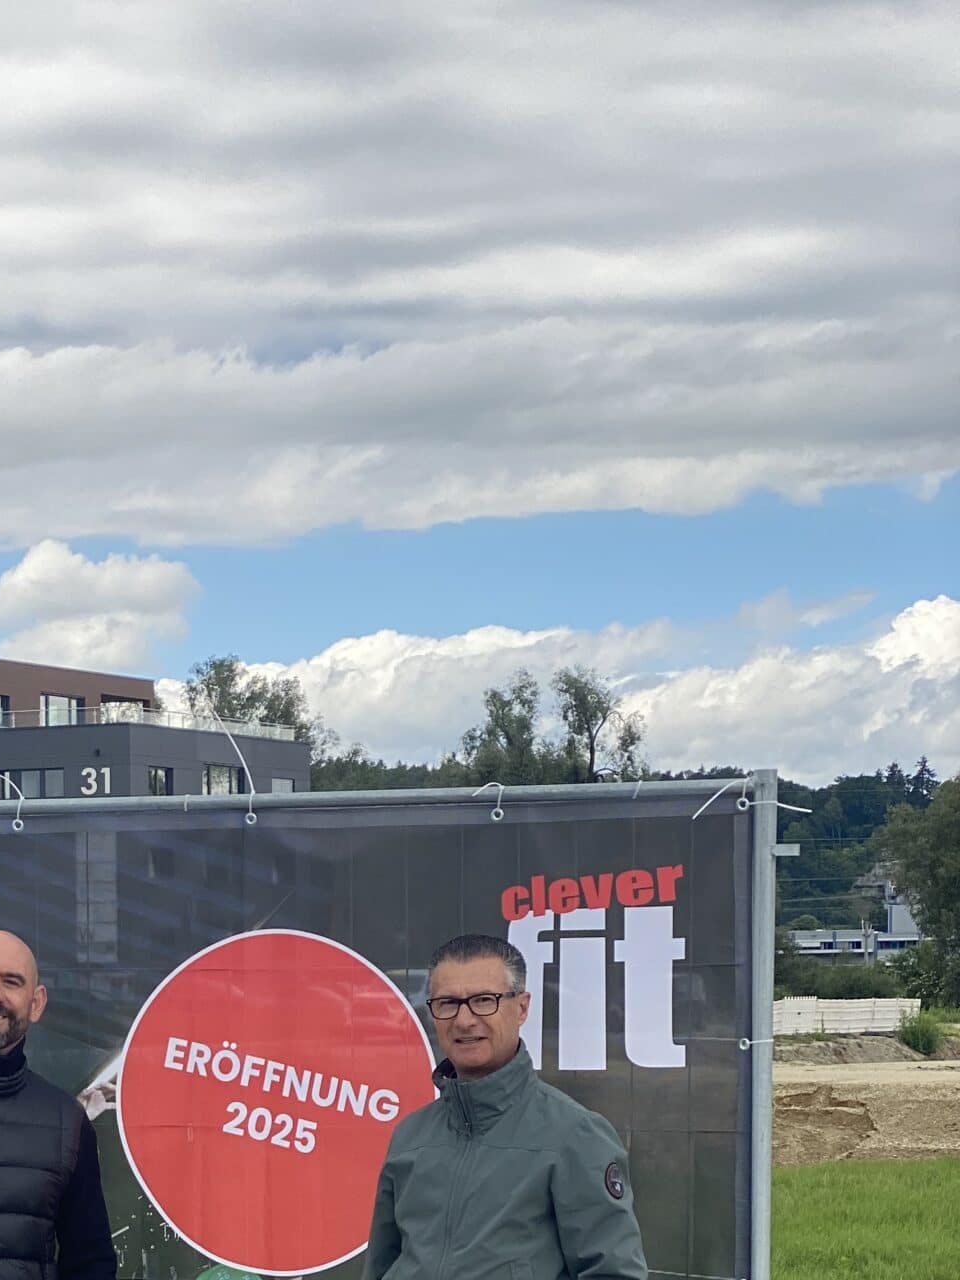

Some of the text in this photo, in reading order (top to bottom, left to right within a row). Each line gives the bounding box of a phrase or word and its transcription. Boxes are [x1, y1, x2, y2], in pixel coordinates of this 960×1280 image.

[81, 767, 111, 795] 31
[501, 864, 683, 921] clever
[508, 906, 686, 1070] fit
[163, 1036, 400, 1122] ERÖFFNUNG
[222, 1101, 318, 1154] 2025
